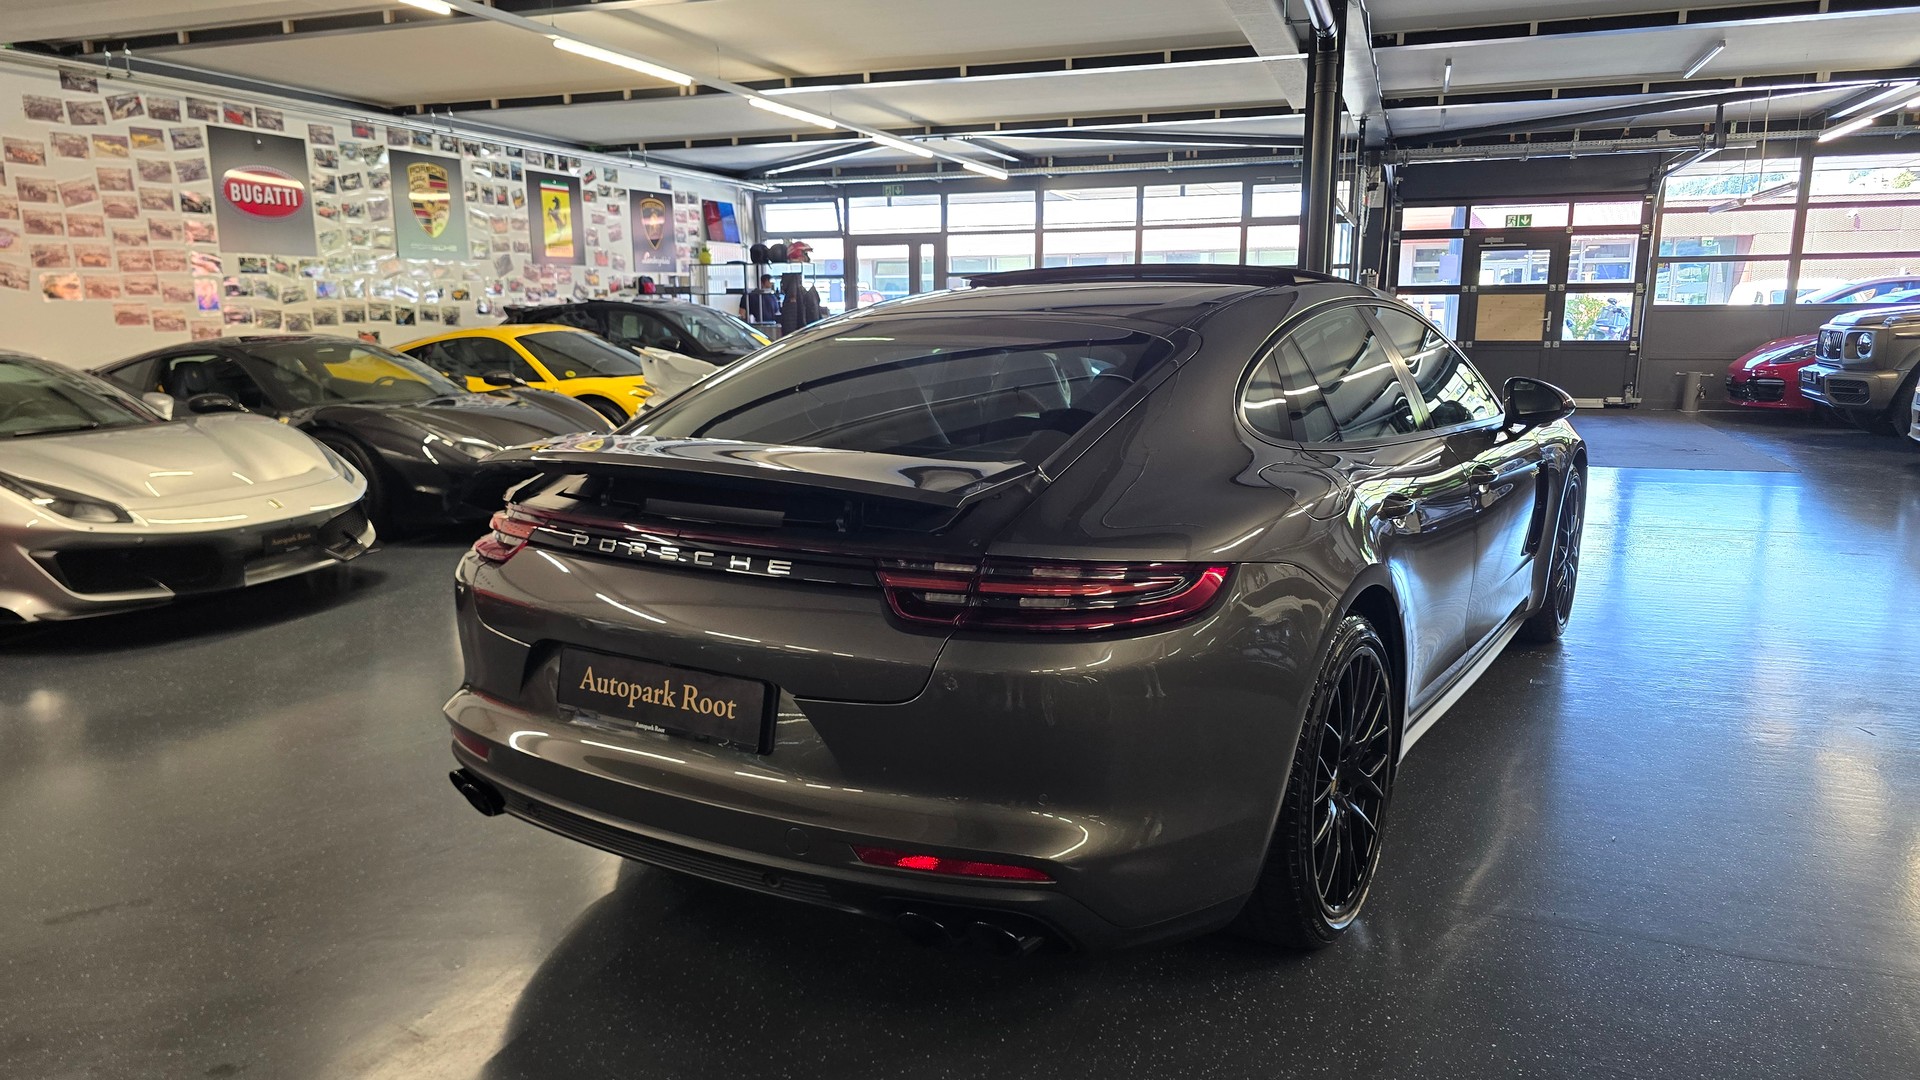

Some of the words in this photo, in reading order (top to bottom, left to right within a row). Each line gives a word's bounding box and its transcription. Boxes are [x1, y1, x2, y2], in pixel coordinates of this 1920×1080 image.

[229, 182, 298, 207] BUGATTI
[572, 533, 791, 576] PORSCHE
[579, 665, 676, 708] Autopark
[679, 684, 737, 720] Root
[634, 721, 654, 731] Autopark
[654, 725, 666, 733] Root
